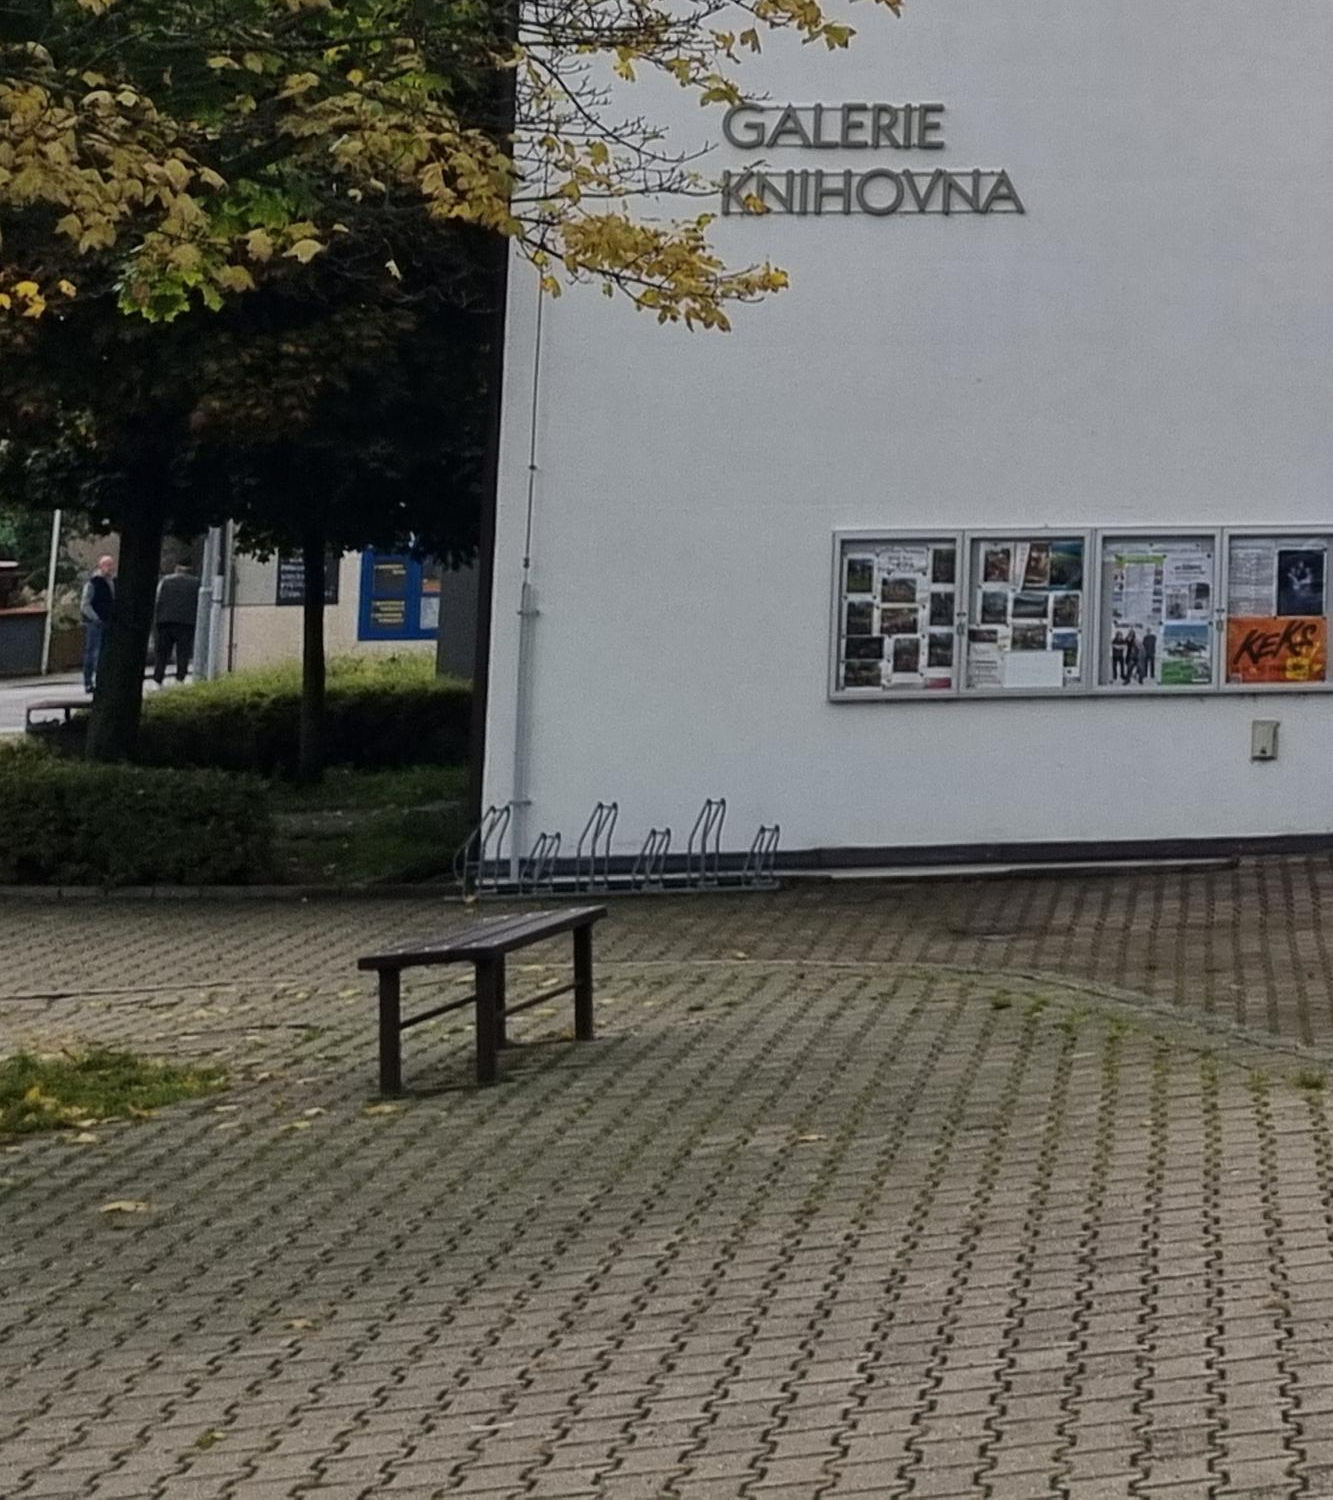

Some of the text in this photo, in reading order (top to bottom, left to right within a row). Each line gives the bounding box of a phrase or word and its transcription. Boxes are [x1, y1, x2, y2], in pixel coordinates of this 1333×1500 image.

[722, 102, 945, 149] GALERIE
[721, 167, 1026, 216] KNIHOVNA
[1232, 620, 1318, 665] KEKS
